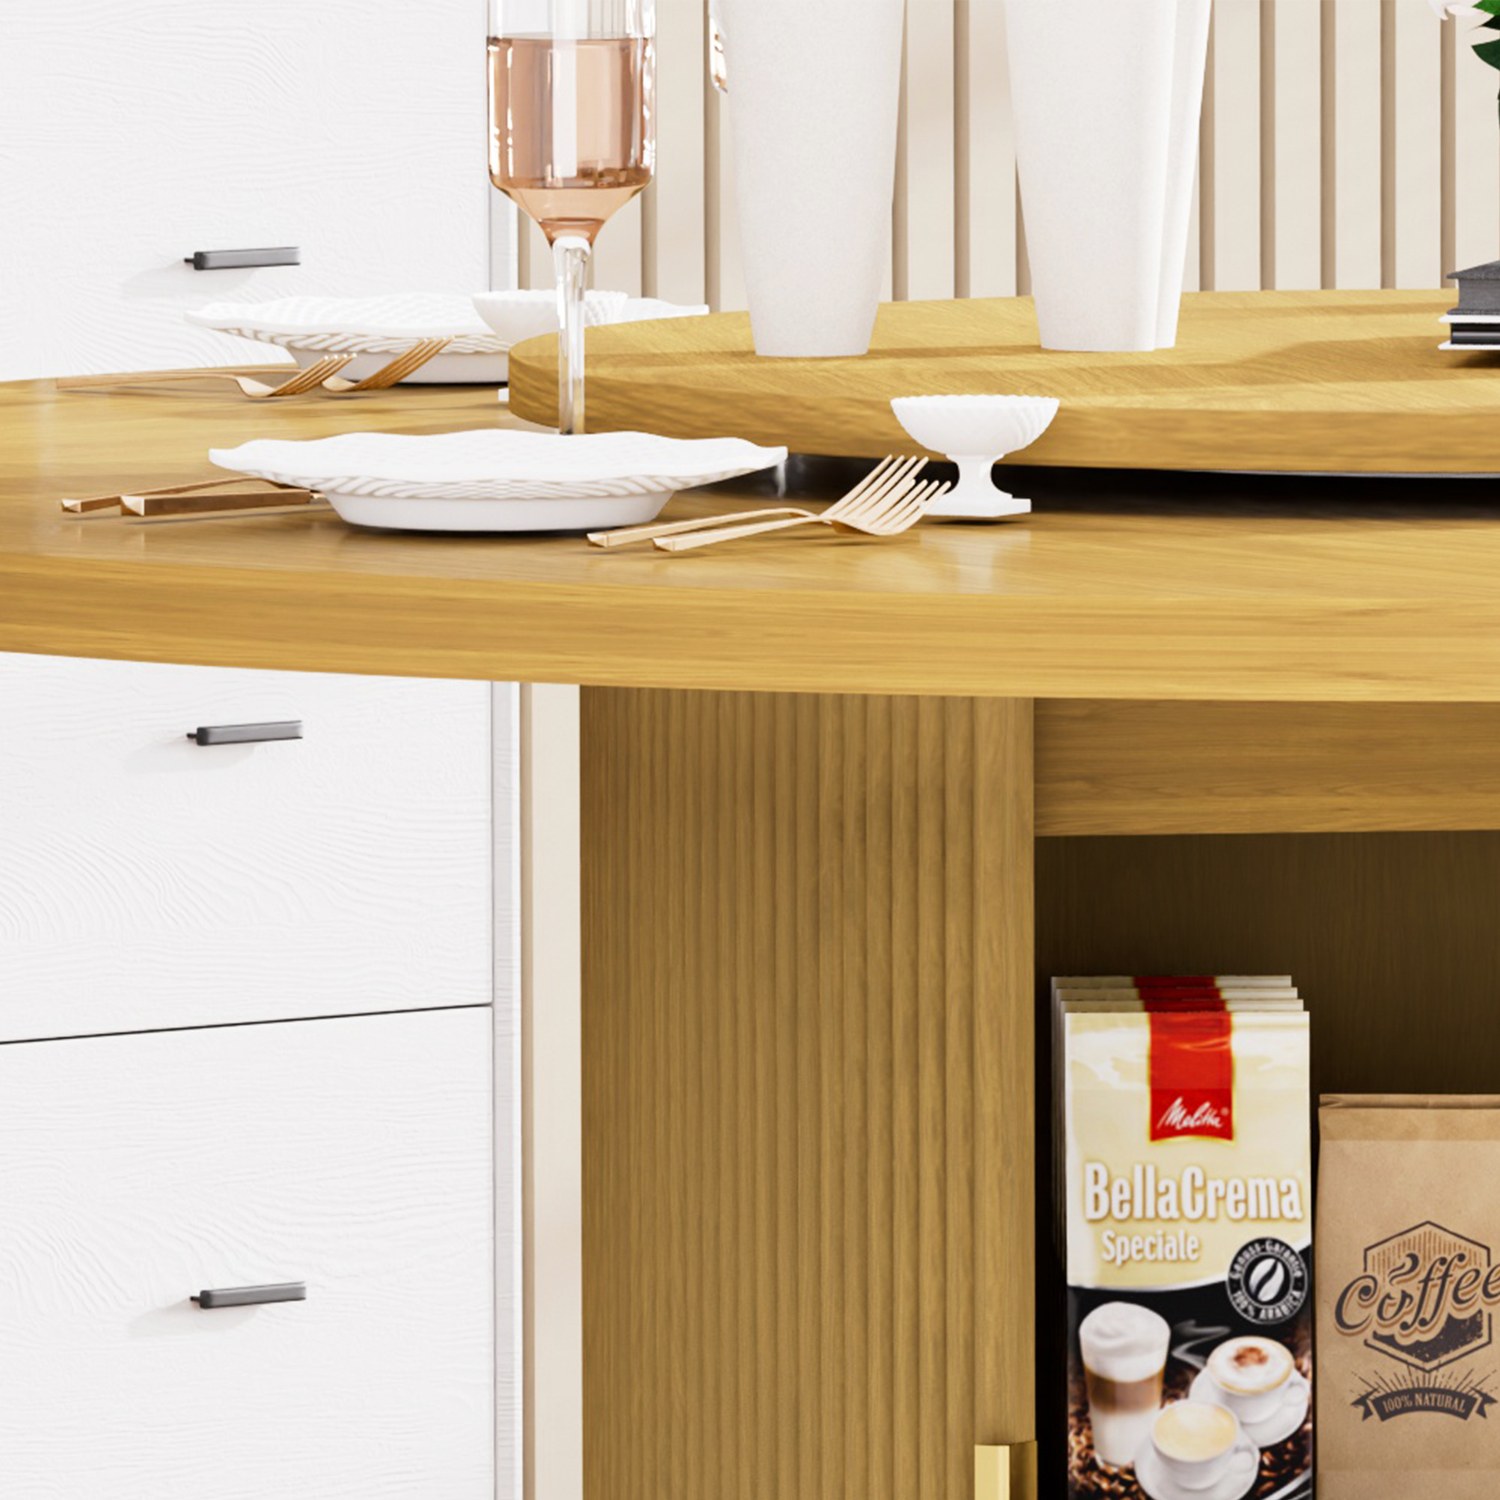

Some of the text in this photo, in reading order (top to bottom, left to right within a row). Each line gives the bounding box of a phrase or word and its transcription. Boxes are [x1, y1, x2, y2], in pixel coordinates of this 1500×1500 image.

[1156, 1096, 1223, 1130] Melitta
[1084, 1162, 1303, 1221] BellaCrema
[1101, 1229, 1200, 1267] Speciale
[1382, 1392, 1466, 1413] 100% NATURAL
